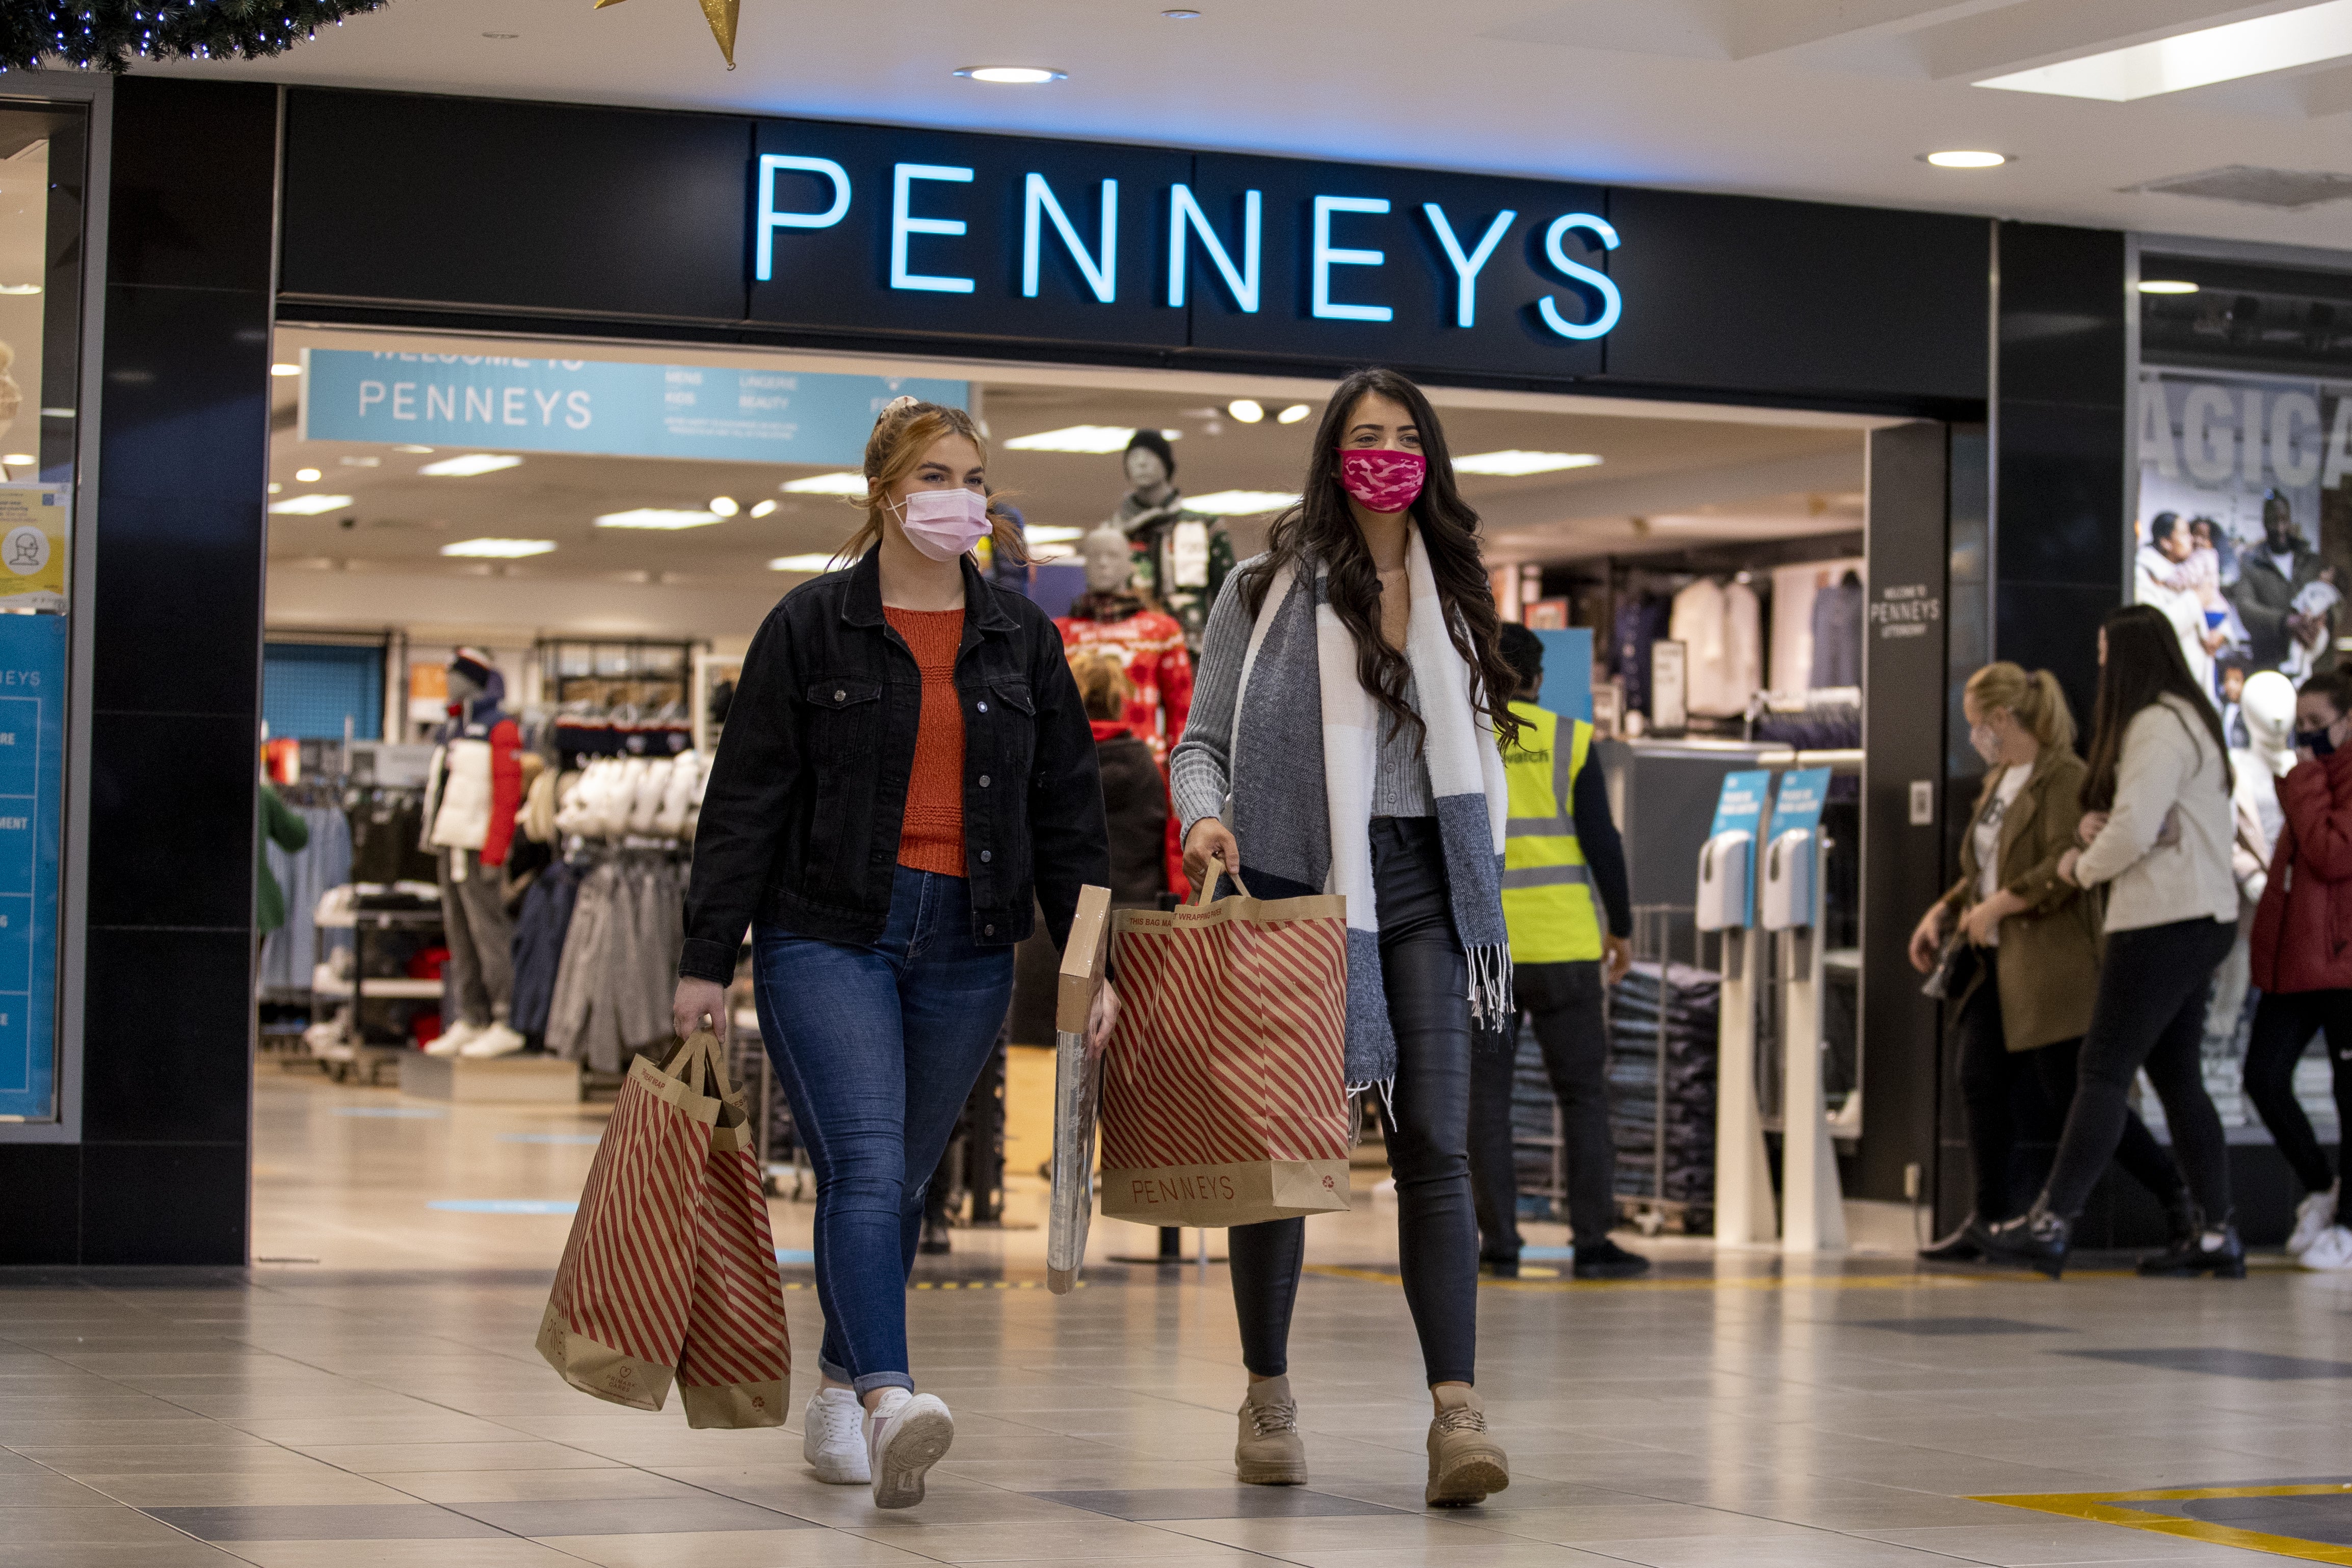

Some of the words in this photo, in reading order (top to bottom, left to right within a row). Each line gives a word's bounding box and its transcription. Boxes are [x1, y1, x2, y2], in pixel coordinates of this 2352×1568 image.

[755, 153, 1623, 341] PENNEYS
[359, 379, 592, 430] PENNEYS
[1871, 598, 1941, 624] PENNEYS
[0, 670, 41, 686] EYS
[1146, 918, 1160, 926] BAG
[1179, 912, 1210, 921] WRAPPING
[1132, 1176, 1234, 1204] PENNEYS
[606, 1375, 636, 1388] PRIMARK
[609, 1382, 630, 1392] CARES
